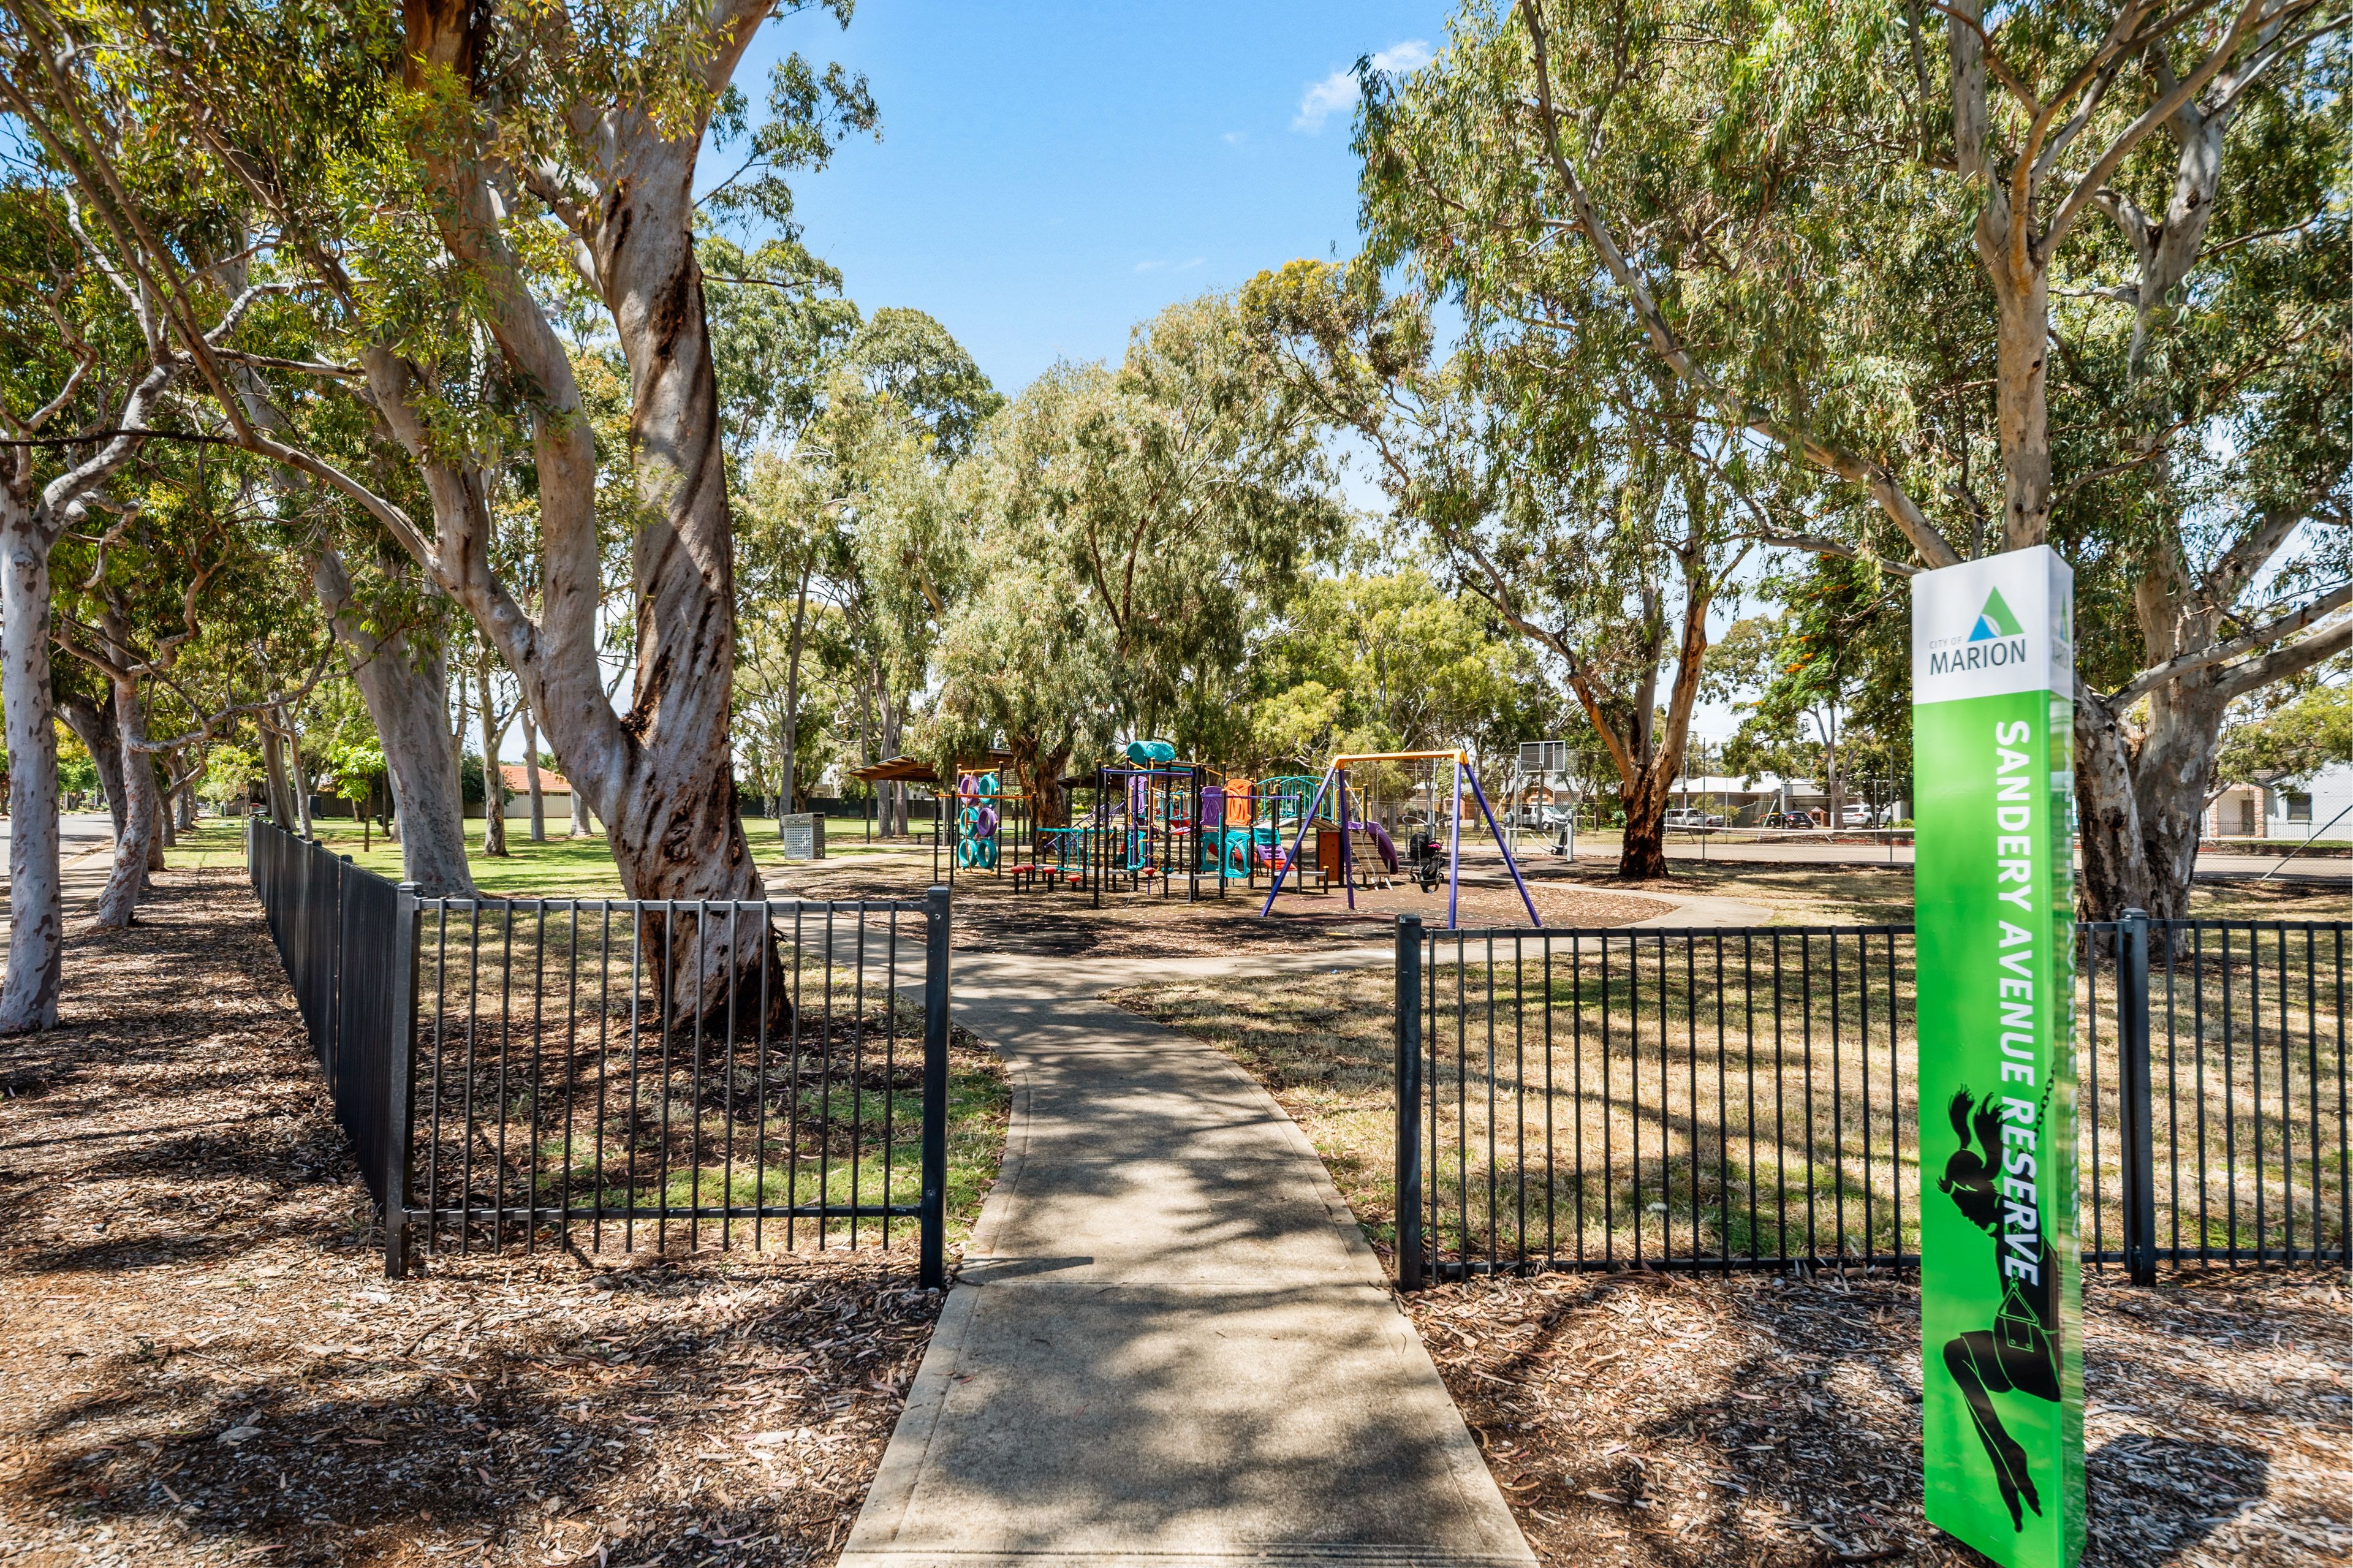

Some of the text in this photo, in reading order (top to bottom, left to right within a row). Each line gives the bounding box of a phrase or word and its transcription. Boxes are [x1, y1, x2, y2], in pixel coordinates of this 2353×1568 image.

[1929, 637, 1961, 649] CITY OF
[1930, 638, 2026, 675] MARION
[1996, 721, 2039, 1286] SANDERY AVENUE RESERVE
